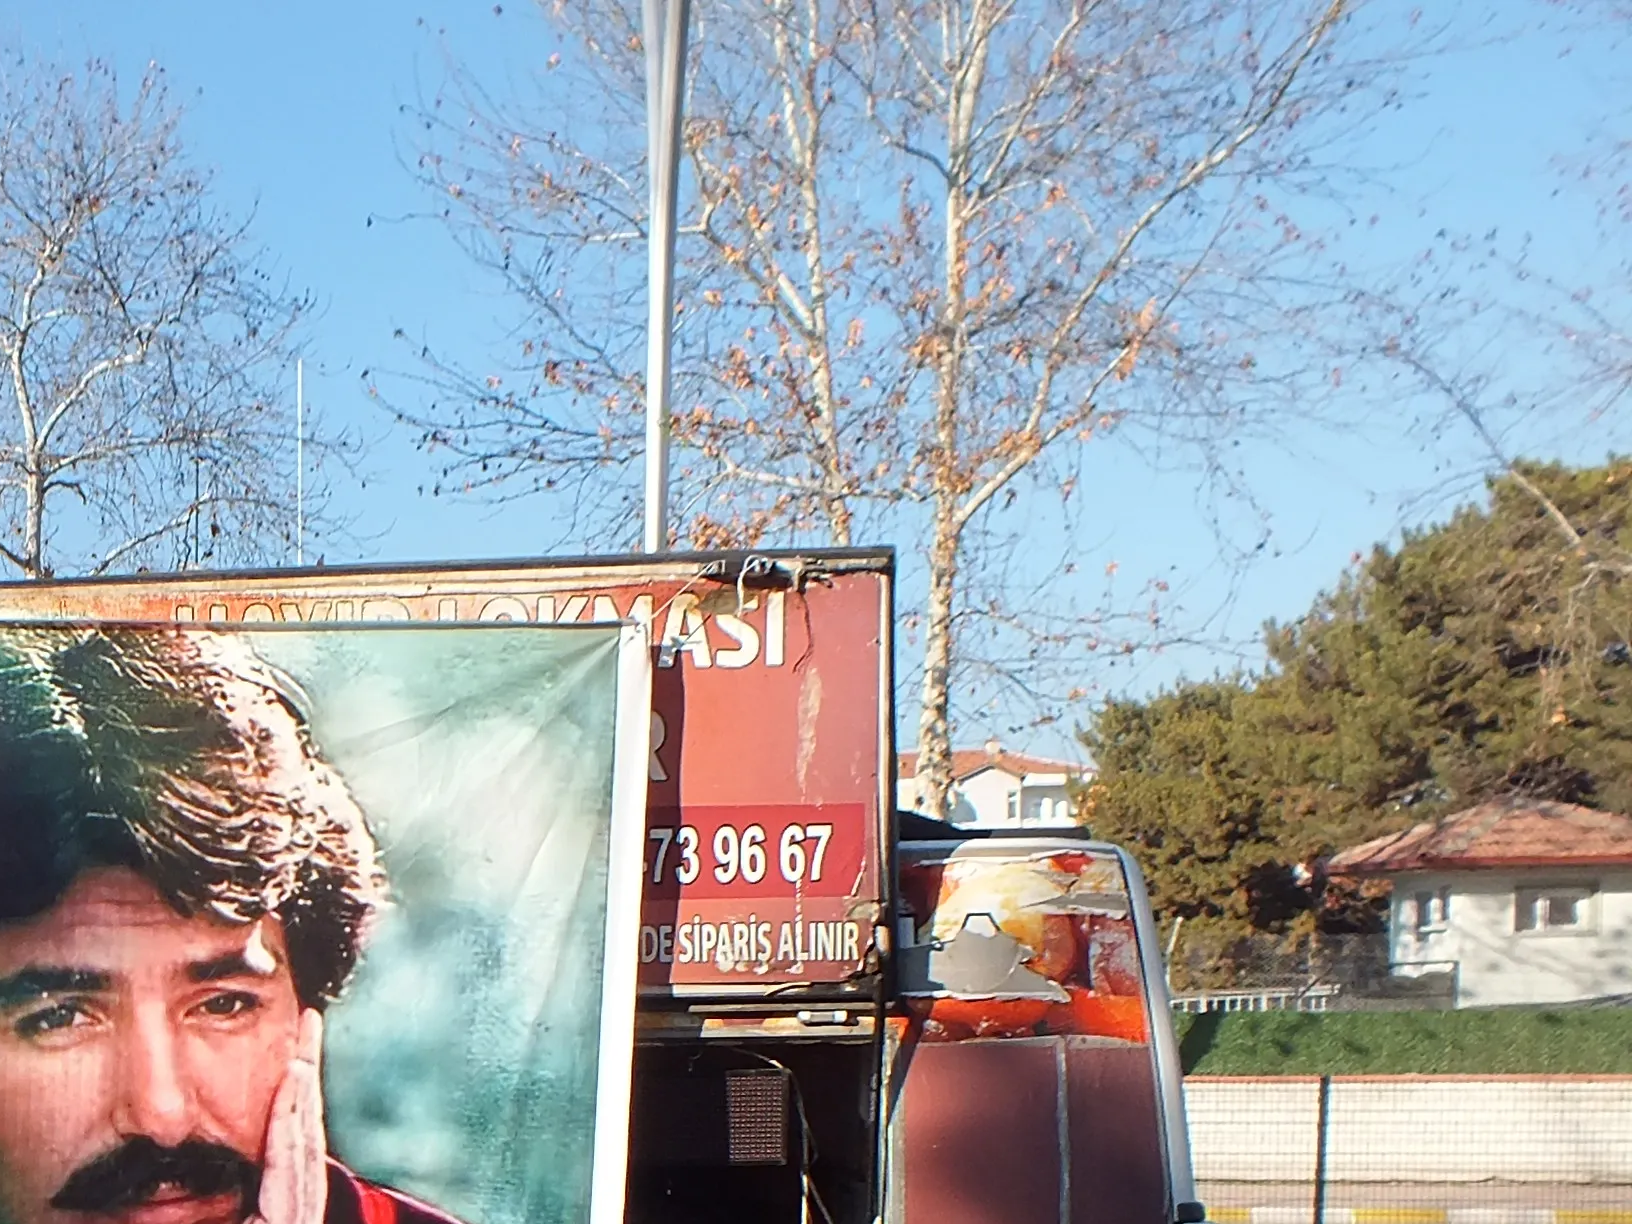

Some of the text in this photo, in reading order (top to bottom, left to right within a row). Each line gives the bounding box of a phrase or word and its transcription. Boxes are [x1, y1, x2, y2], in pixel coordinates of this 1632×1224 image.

[642, 823, 833, 885] 73 96 67
[678, 914, 772, 967] SİPARİŞ
[777, 920, 859, 961] ALINIR
